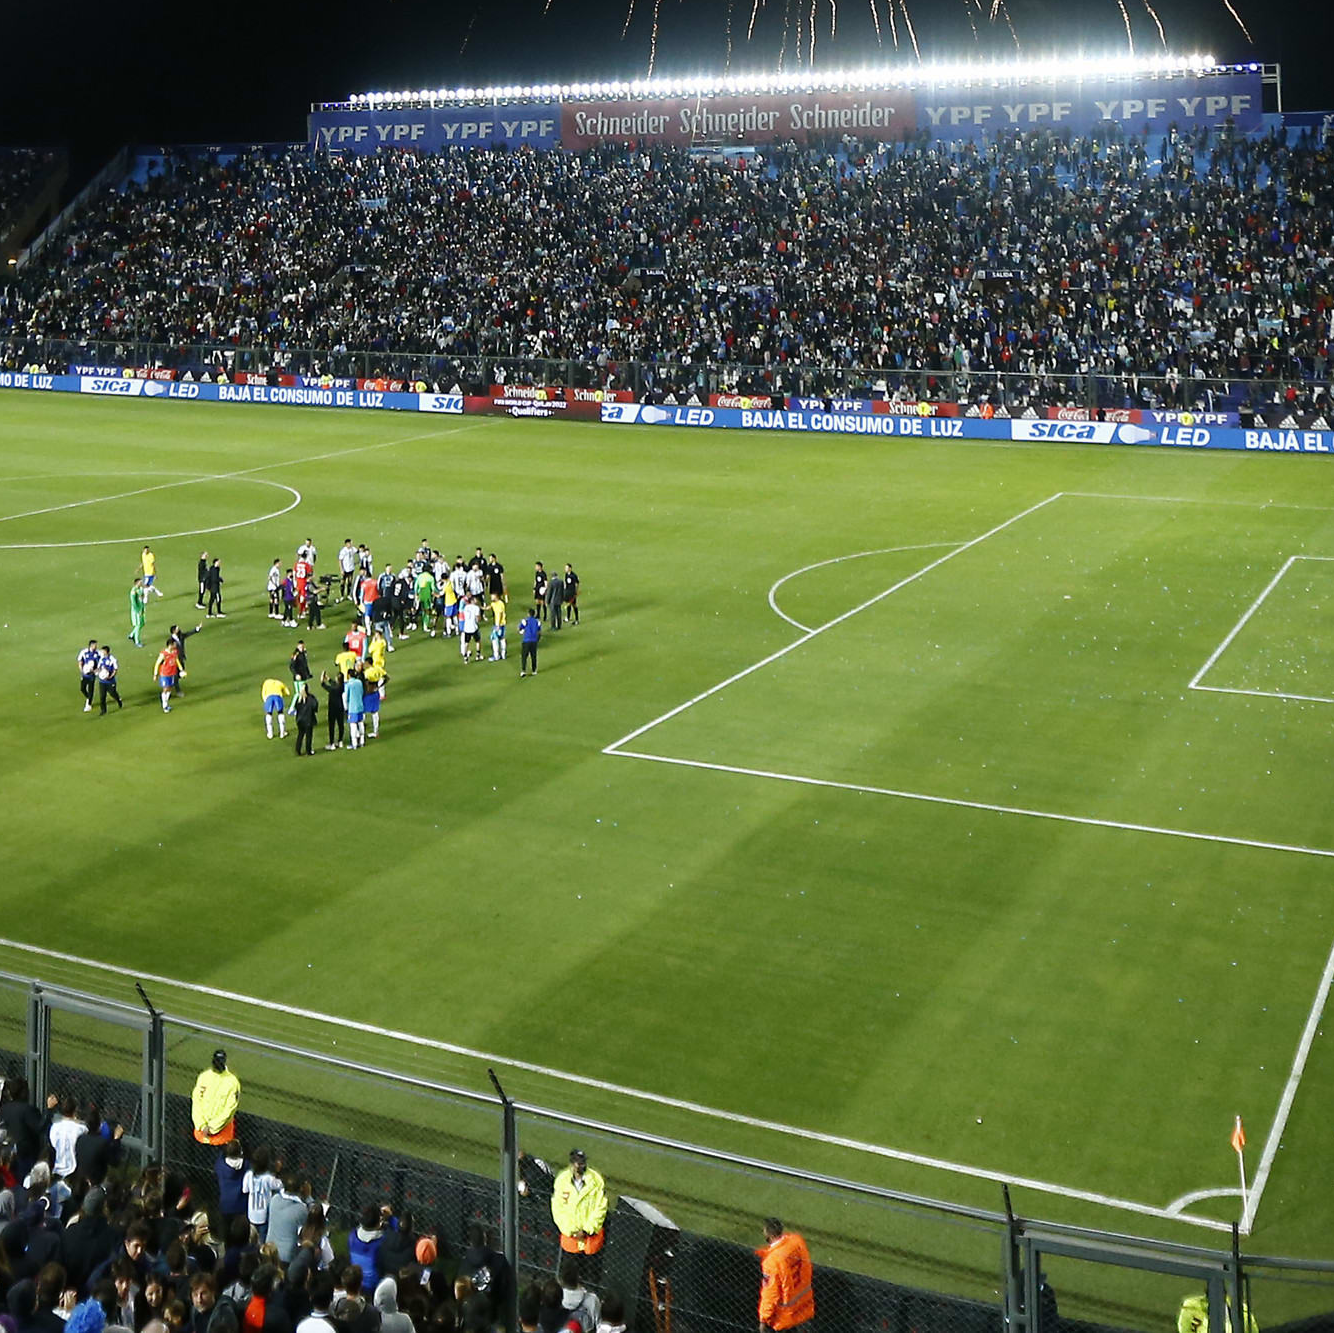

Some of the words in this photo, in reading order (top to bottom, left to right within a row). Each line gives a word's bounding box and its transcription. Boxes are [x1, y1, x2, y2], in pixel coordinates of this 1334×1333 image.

[924, 105, 992, 125] YPF
[1002, 102, 1072, 123] YPF
[1095, 99, 1166, 120] YPF
[1177, 95, 1252, 116] YPF
[575, 109, 670, 136] Schneider
[679, 107, 780, 133] Schneider
[789, 101, 895, 131] Schneider
[320, 126, 369, 143] YPF
[375, 124, 425, 141] YPF
[442, 121, 494, 140] YPF
[501, 120, 555, 137] YPF
[75, 366, 95, 376] YPF
[96, 367, 117, 377] YPF
[14, 375, 28, 388] DE
[32, 376, 53, 389] LUZ
[169, 383, 199, 398] LED
[219, 385, 251, 402] BAJÁ
[254, 388, 269, 402] EL
[270, 389, 332, 405] CONSUMO
[337, 392, 354, 406] DE
[359, 393, 384, 407] LUZ
[512, 406, 548, 417] Qualifiers
[833, 401, 862, 411] YPF
[674, 409, 715, 426] LED
[742, 409, 782, 428] BAJÁ
[788, 412, 807, 429] EL
[810, 413, 894, 434] CONSUMO
[900, 418, 923, 435] DE
[931, 420, 964, 436] LUZ
[1193, 413, 1228, 425] YPF
[1160, 427, 1211, 446] LED
[1245, 429, 1298, 451] BAJÁ
[1305, 432, 1328, 452] EL
